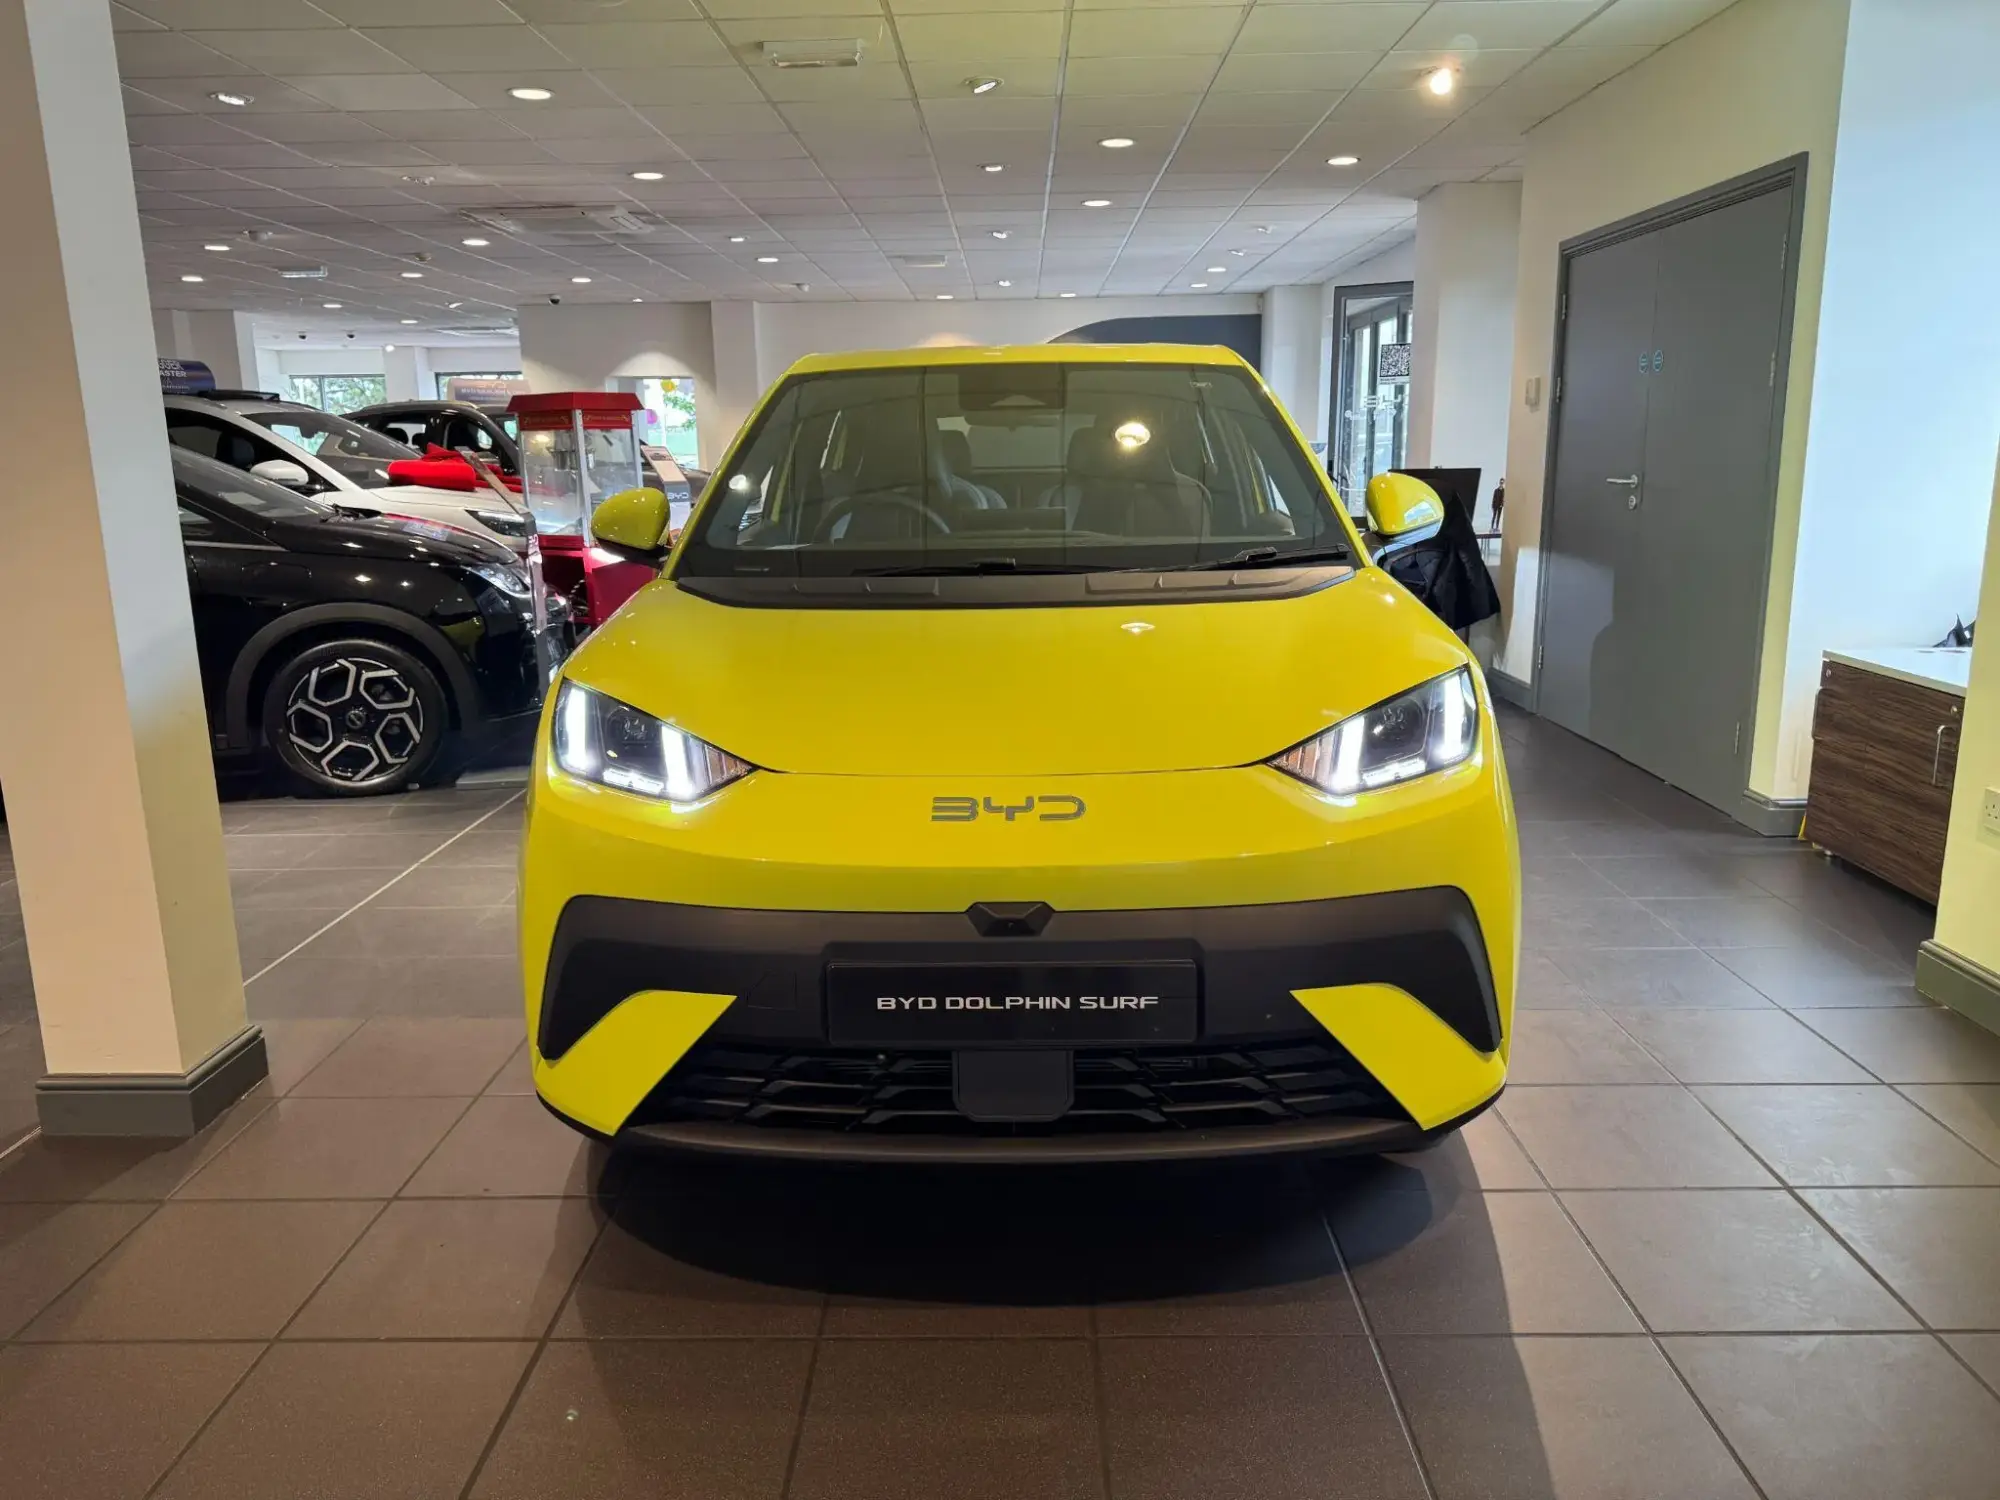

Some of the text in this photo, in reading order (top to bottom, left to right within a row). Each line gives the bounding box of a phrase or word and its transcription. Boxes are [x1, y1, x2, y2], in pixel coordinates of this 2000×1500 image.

[931, 794, 1087, 821] BYD
[877, 996, 1159, 1010] BYD DOLPHIN SURF
